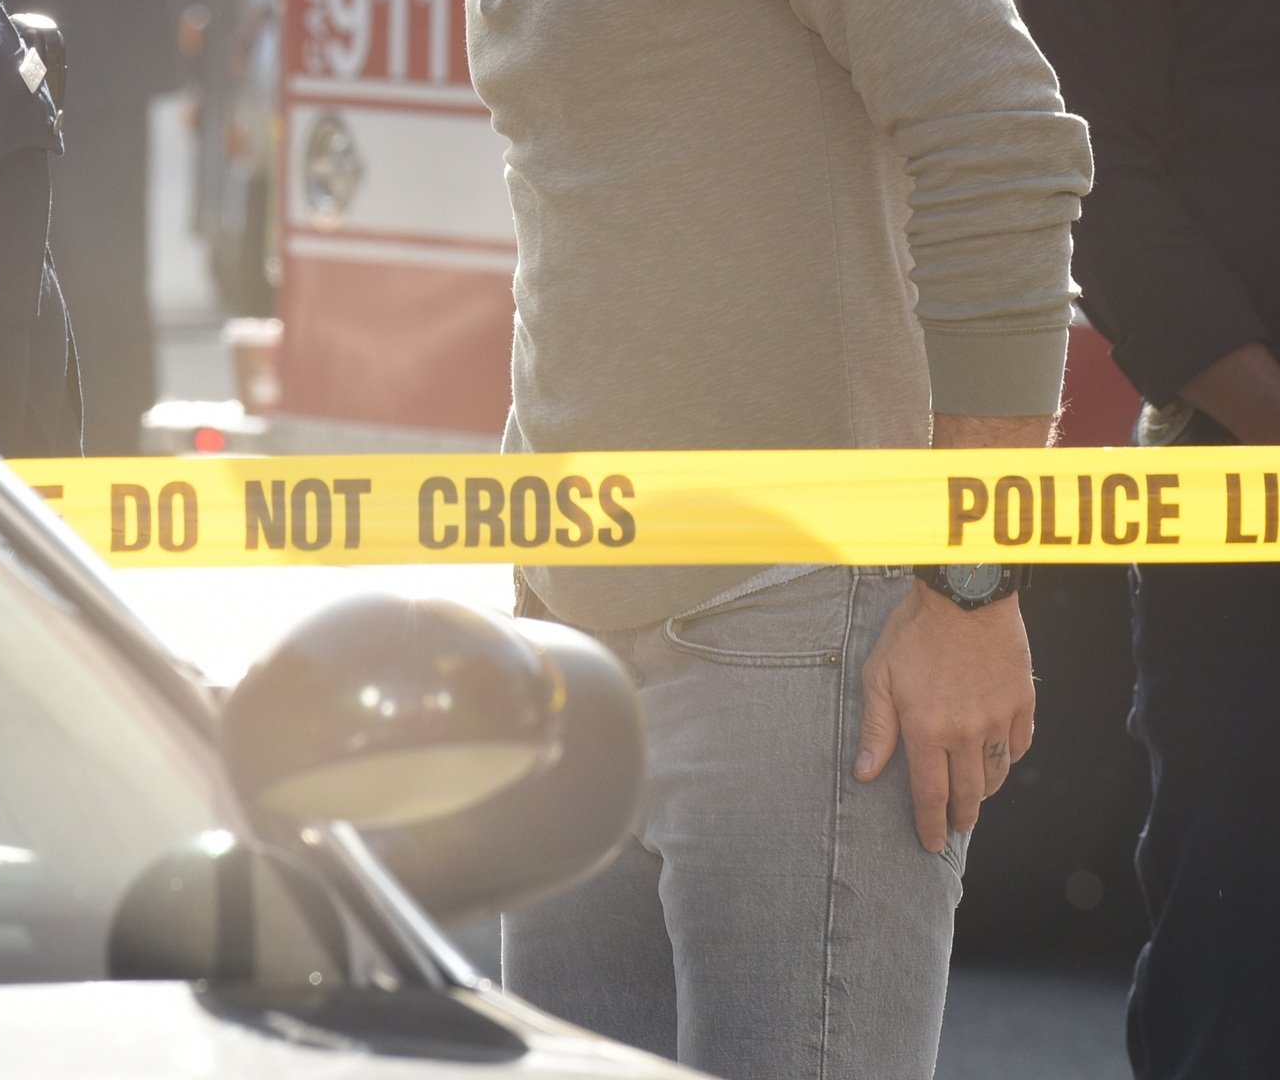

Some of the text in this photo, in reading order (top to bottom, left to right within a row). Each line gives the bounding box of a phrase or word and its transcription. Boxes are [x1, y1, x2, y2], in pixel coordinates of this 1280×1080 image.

[110, 482, 198, 552] DO
[245, 478, 371, 551] NOT
[418, 474, 636, 550] CROSS
[947, 473, 1180, 546] POLICE
